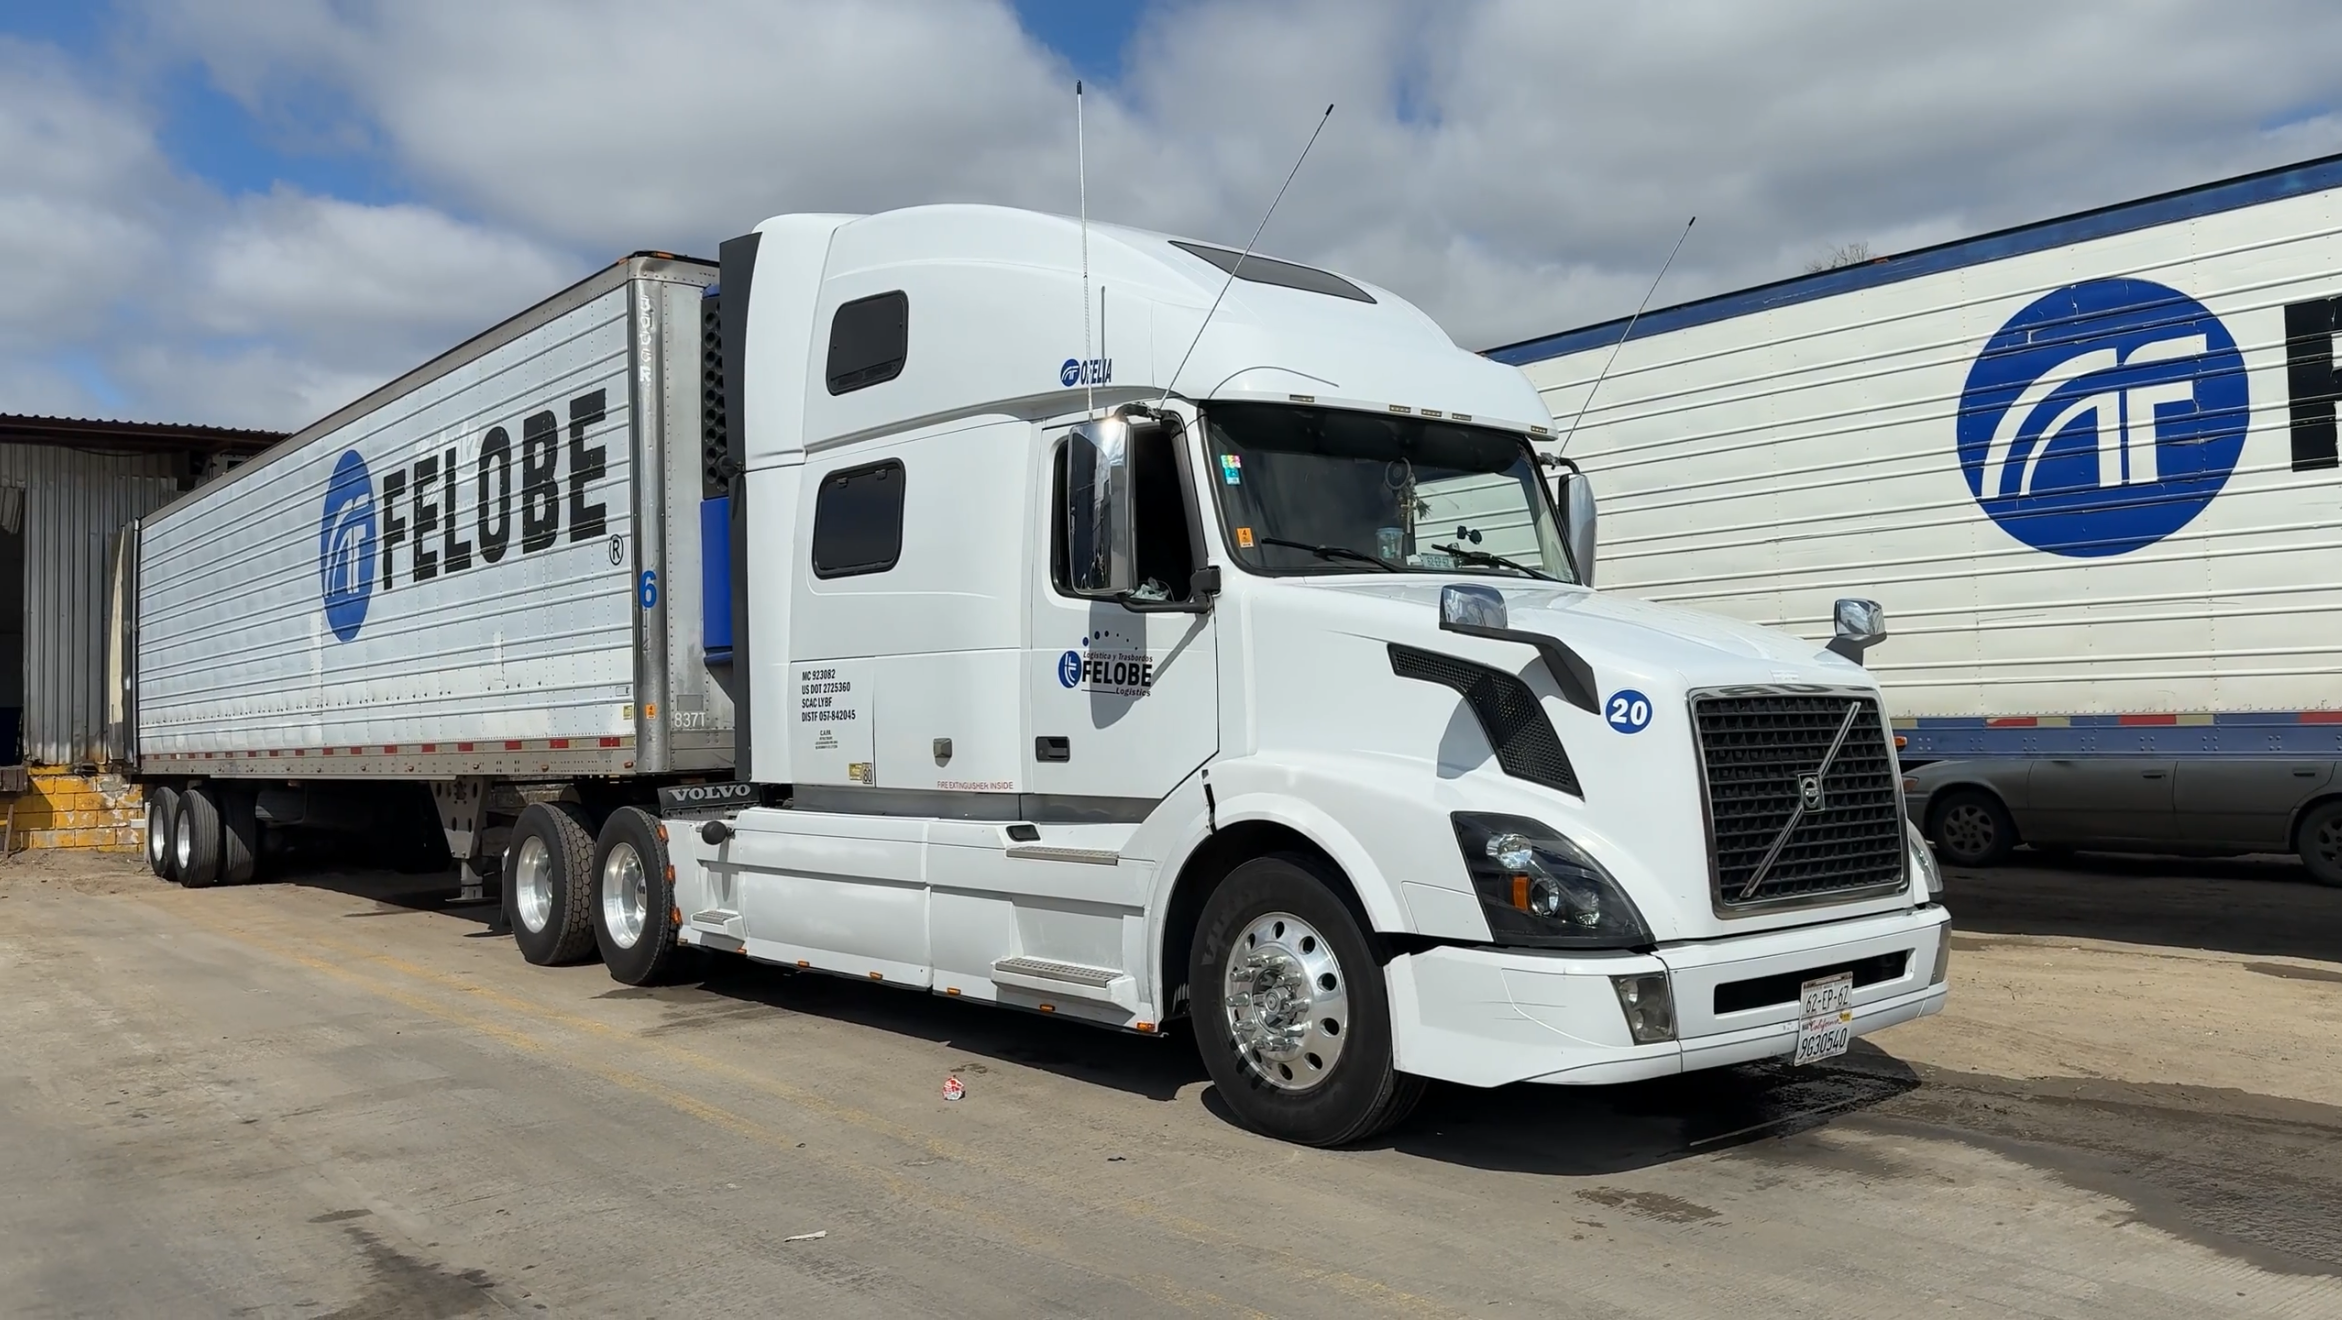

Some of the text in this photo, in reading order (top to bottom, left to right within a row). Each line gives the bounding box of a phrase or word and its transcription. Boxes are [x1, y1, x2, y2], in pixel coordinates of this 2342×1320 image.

[382, 388, 607, 591] FELOBE
[640, 570, 657, 608] 6
[1118, 653, 1153, 663] Trasbordos
[802, 668, 836, 681] MC 923082
[1082, 660, 1153, 687] FELOBE
[801, 681, 851, 695] US DOT 2725360
[1115, 687, 1152, 697] Logistics
[801, 697, 817, 709] SCAC
[819, 709, 856, 721] 057-842045
[1610, 697, 1648, 726] 20
[674, 712, 706, 728] 837T
[863, 768, 872, 782] 80
[668, 784, 751, 801] VOLVO
[937, 781, 1014, 790] FIRE EXTINGUISHER INSIDE
[1798, 1027, 1848, 1060] 9G30540
